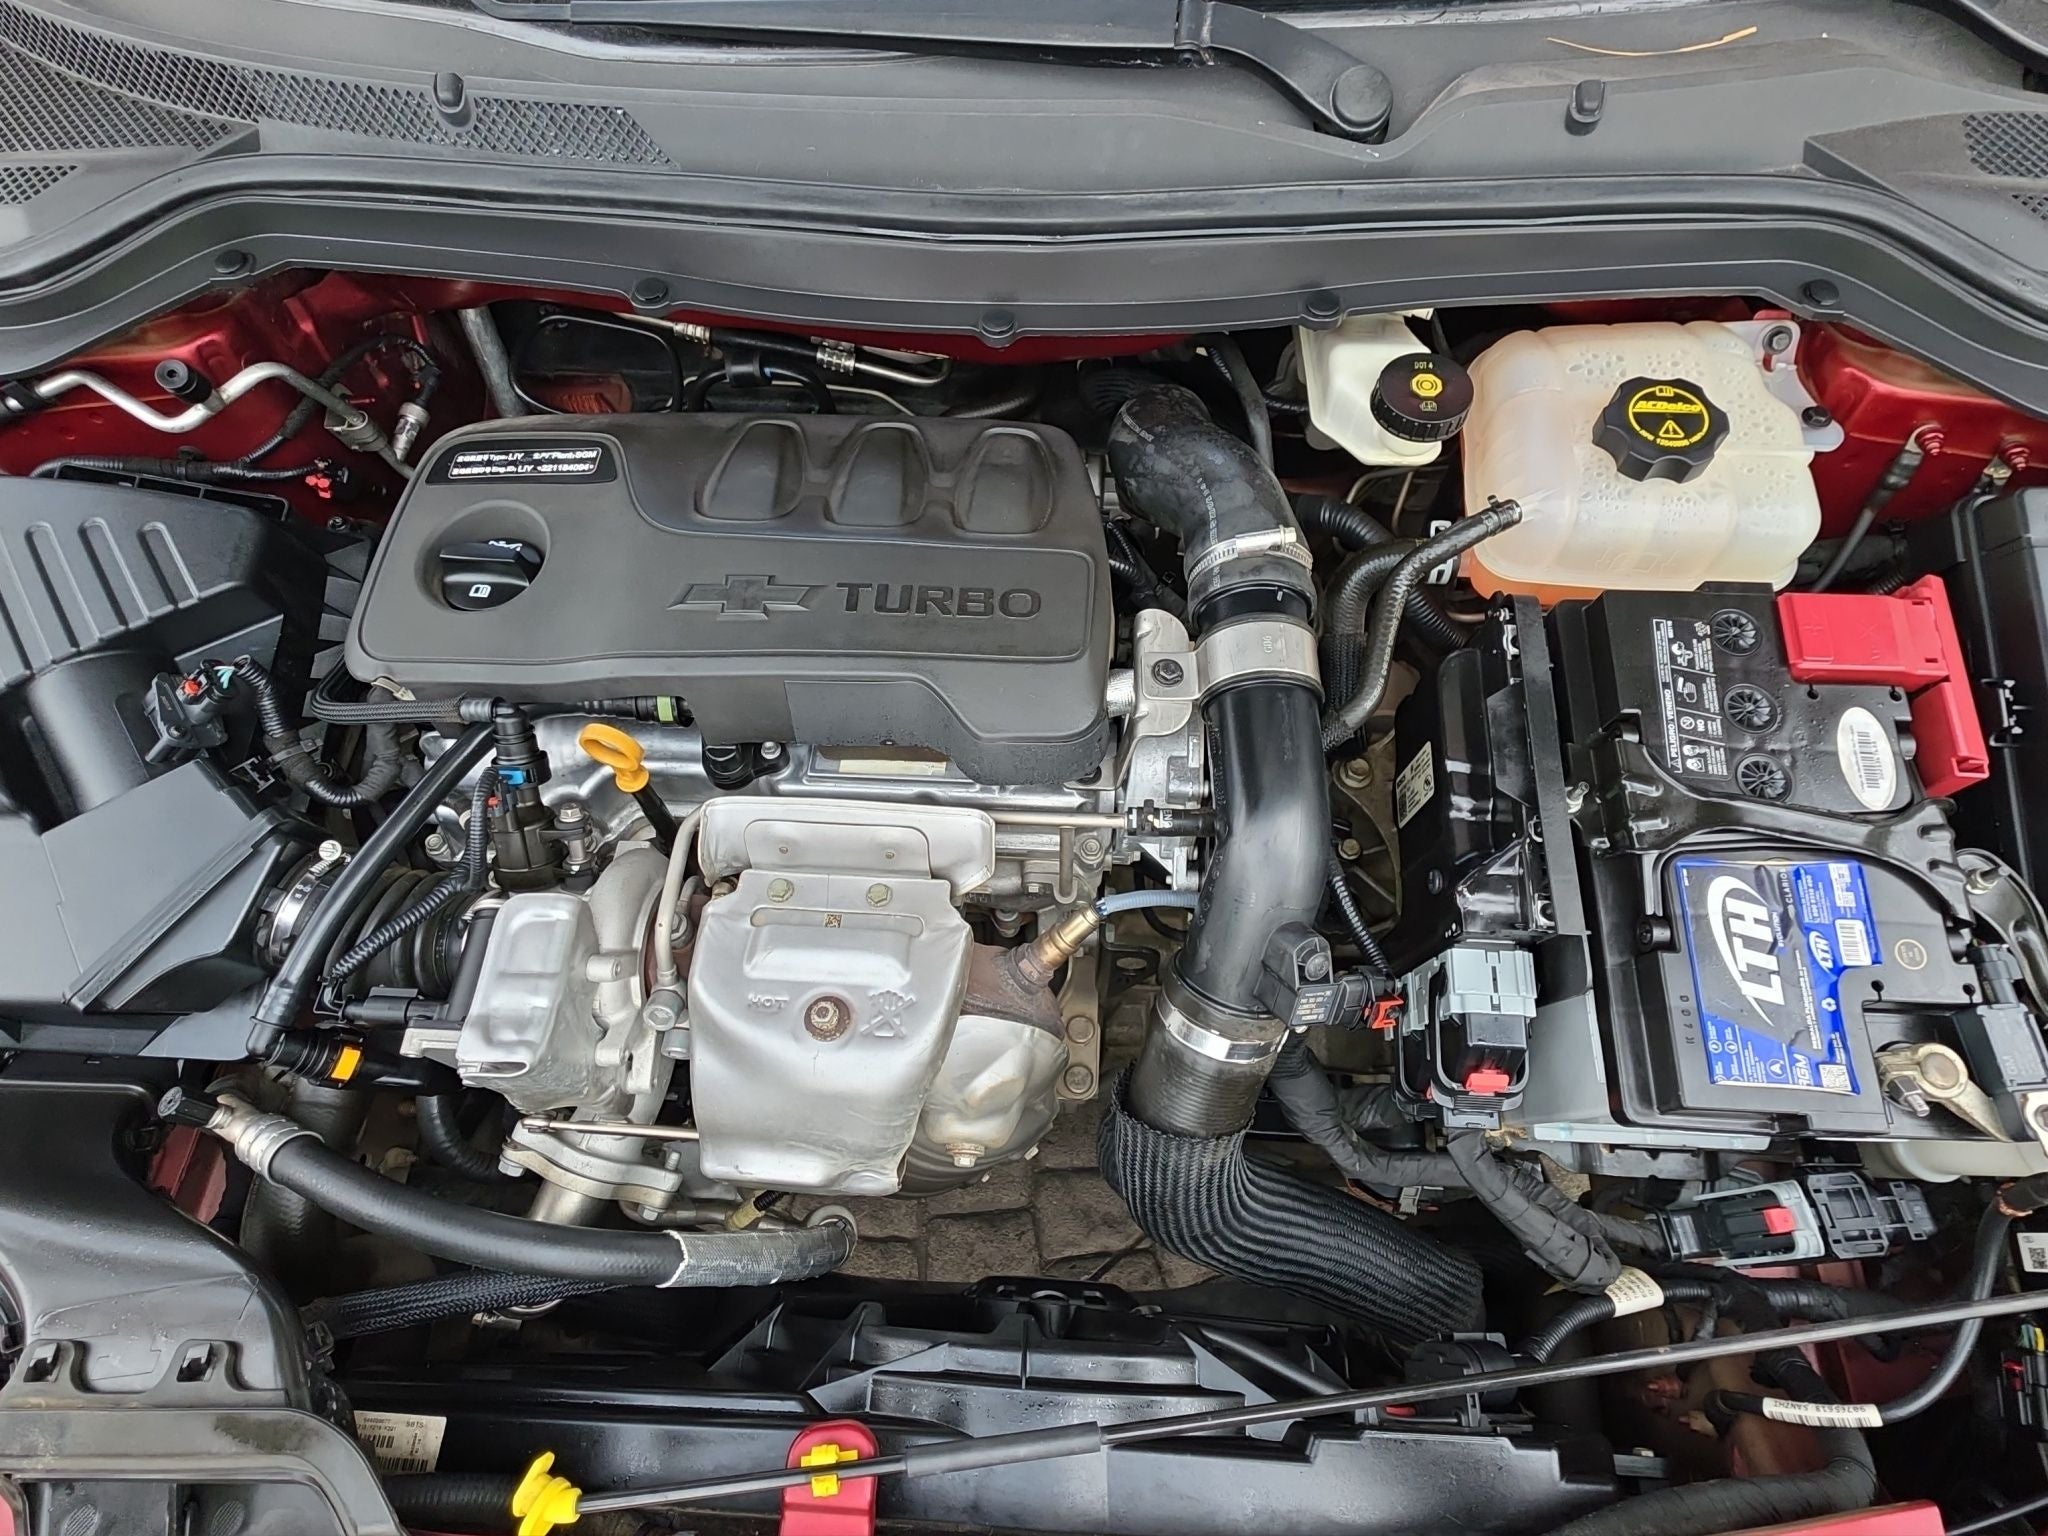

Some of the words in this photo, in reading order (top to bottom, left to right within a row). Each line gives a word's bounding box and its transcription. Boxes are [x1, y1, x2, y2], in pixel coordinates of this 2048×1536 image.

[1414, 361, 1427, 370] DOT
[1428, 361, 1434, 369] 4
[1634, 401, 1702, 412] ACDelco
[836, 582, 1042, 621] TURBO
[1696, 719, 1706, 732] NO
[1725, 896, 1785, 1006] LTH
[747, 993, 790, 1010] HOT
